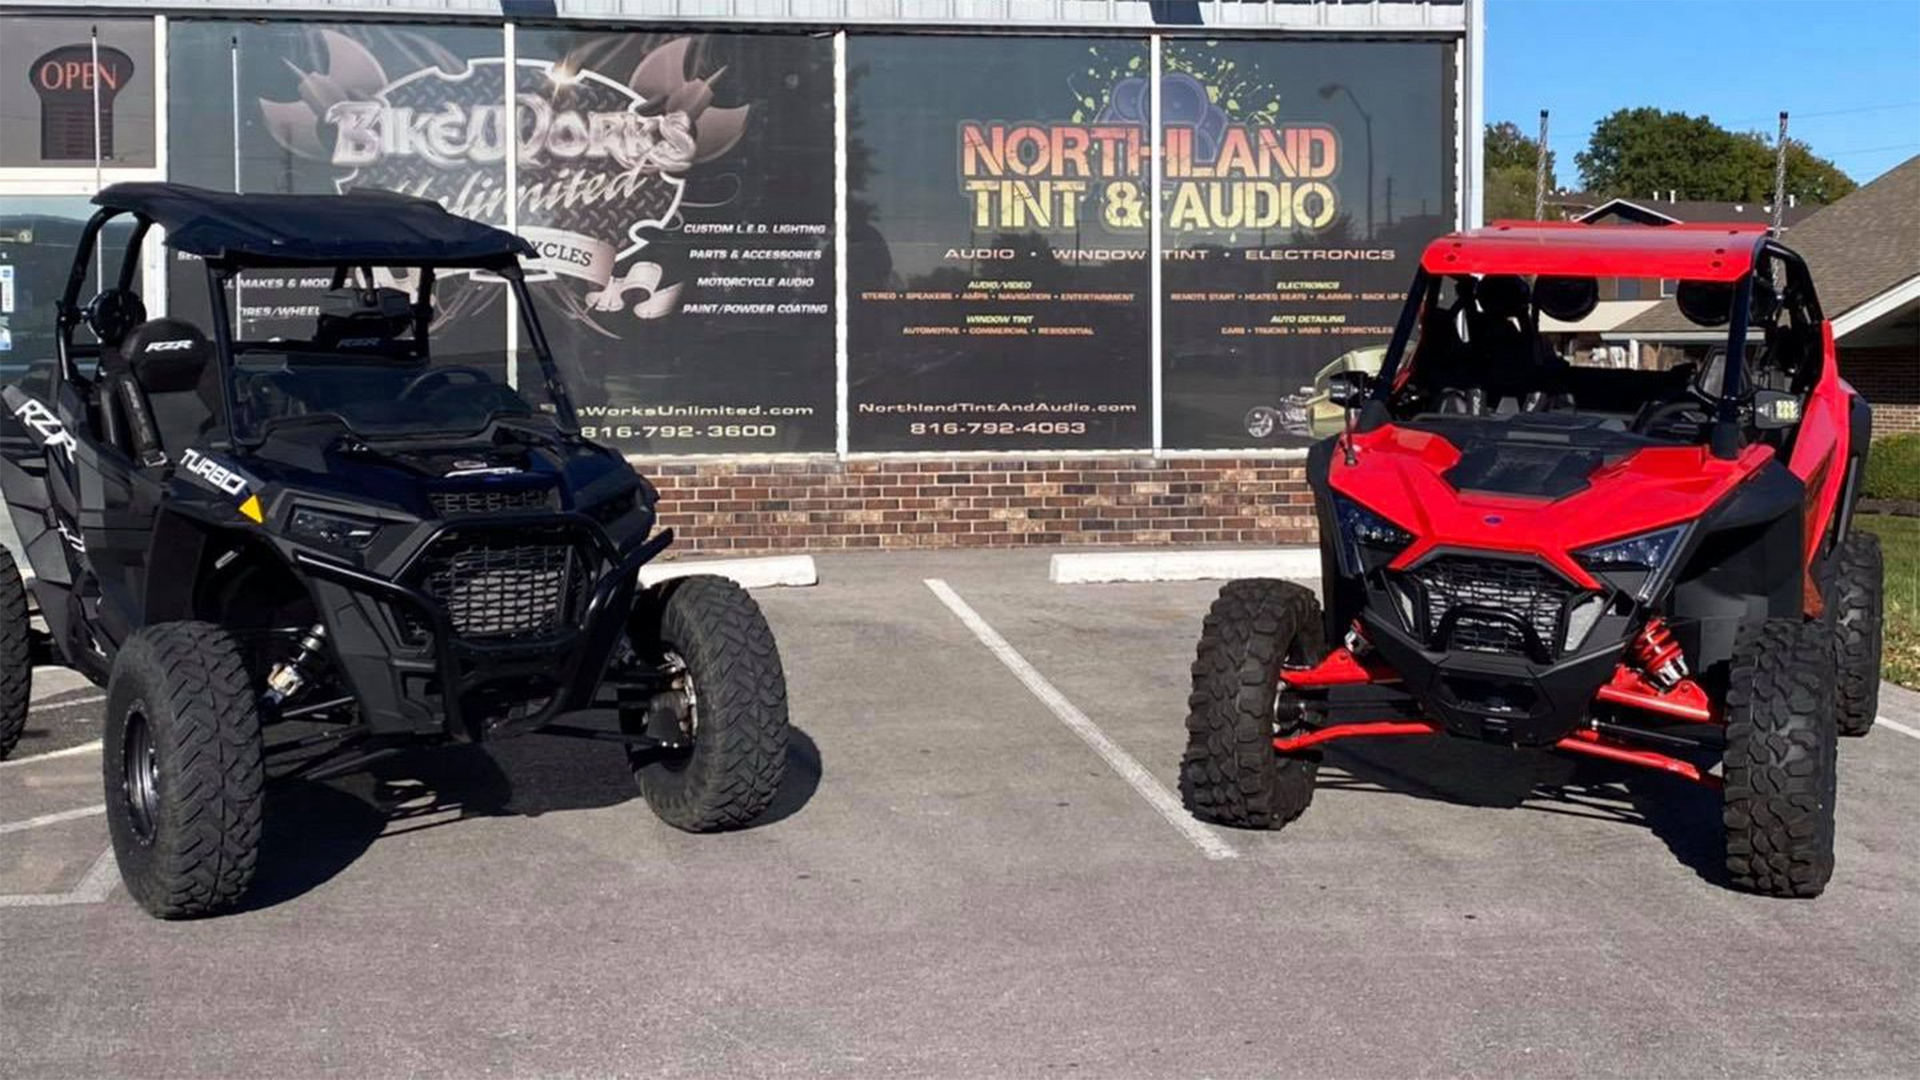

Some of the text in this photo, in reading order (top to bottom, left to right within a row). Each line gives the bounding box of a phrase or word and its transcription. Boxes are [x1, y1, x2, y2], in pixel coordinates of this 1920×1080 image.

[41, 61, 116, 89] OPEN
[963, 125, 1336, 178] NORTHLAND
[965, 181, 1334, 228] TINT & AUDIO
[684, 224, 826, 234] CUSTOM L.E.D. LIGHTING
[530, 240, 593, 266] YCLES
[689, 250, 822, 260] PARTS & ACCESSORIES
[943, 249, 1396, 260] AUDIO WINDOW TINT ELECTRONICS
[240, 278, 283, 288] MAKES
[287, 278, 296, 288] &
[697, 277, 814, 288] MOTORCYCLE AUDIO
[967, 281, 1032, 290] AUDIO/VIDEO
[1276, 282, 1340, 290] ELECTRONICS
[682, 304, 828, 315] PAINT/POWDER COATING
[966, 315, 1034, 324] WINDOW TINT
[1270, 315, 1296, 323] AUTO
[145, 339, 192, 352] RZR
[858, 403, 1137, 413] NorthlandTintAndAudio.com
[15, 399, 77, 464] RZR
[580, 425, 776, 438] 816-792-3600
[910, 422, 1086, 435] 816-792-4063
[179, 448, 247, 495] TURBO
